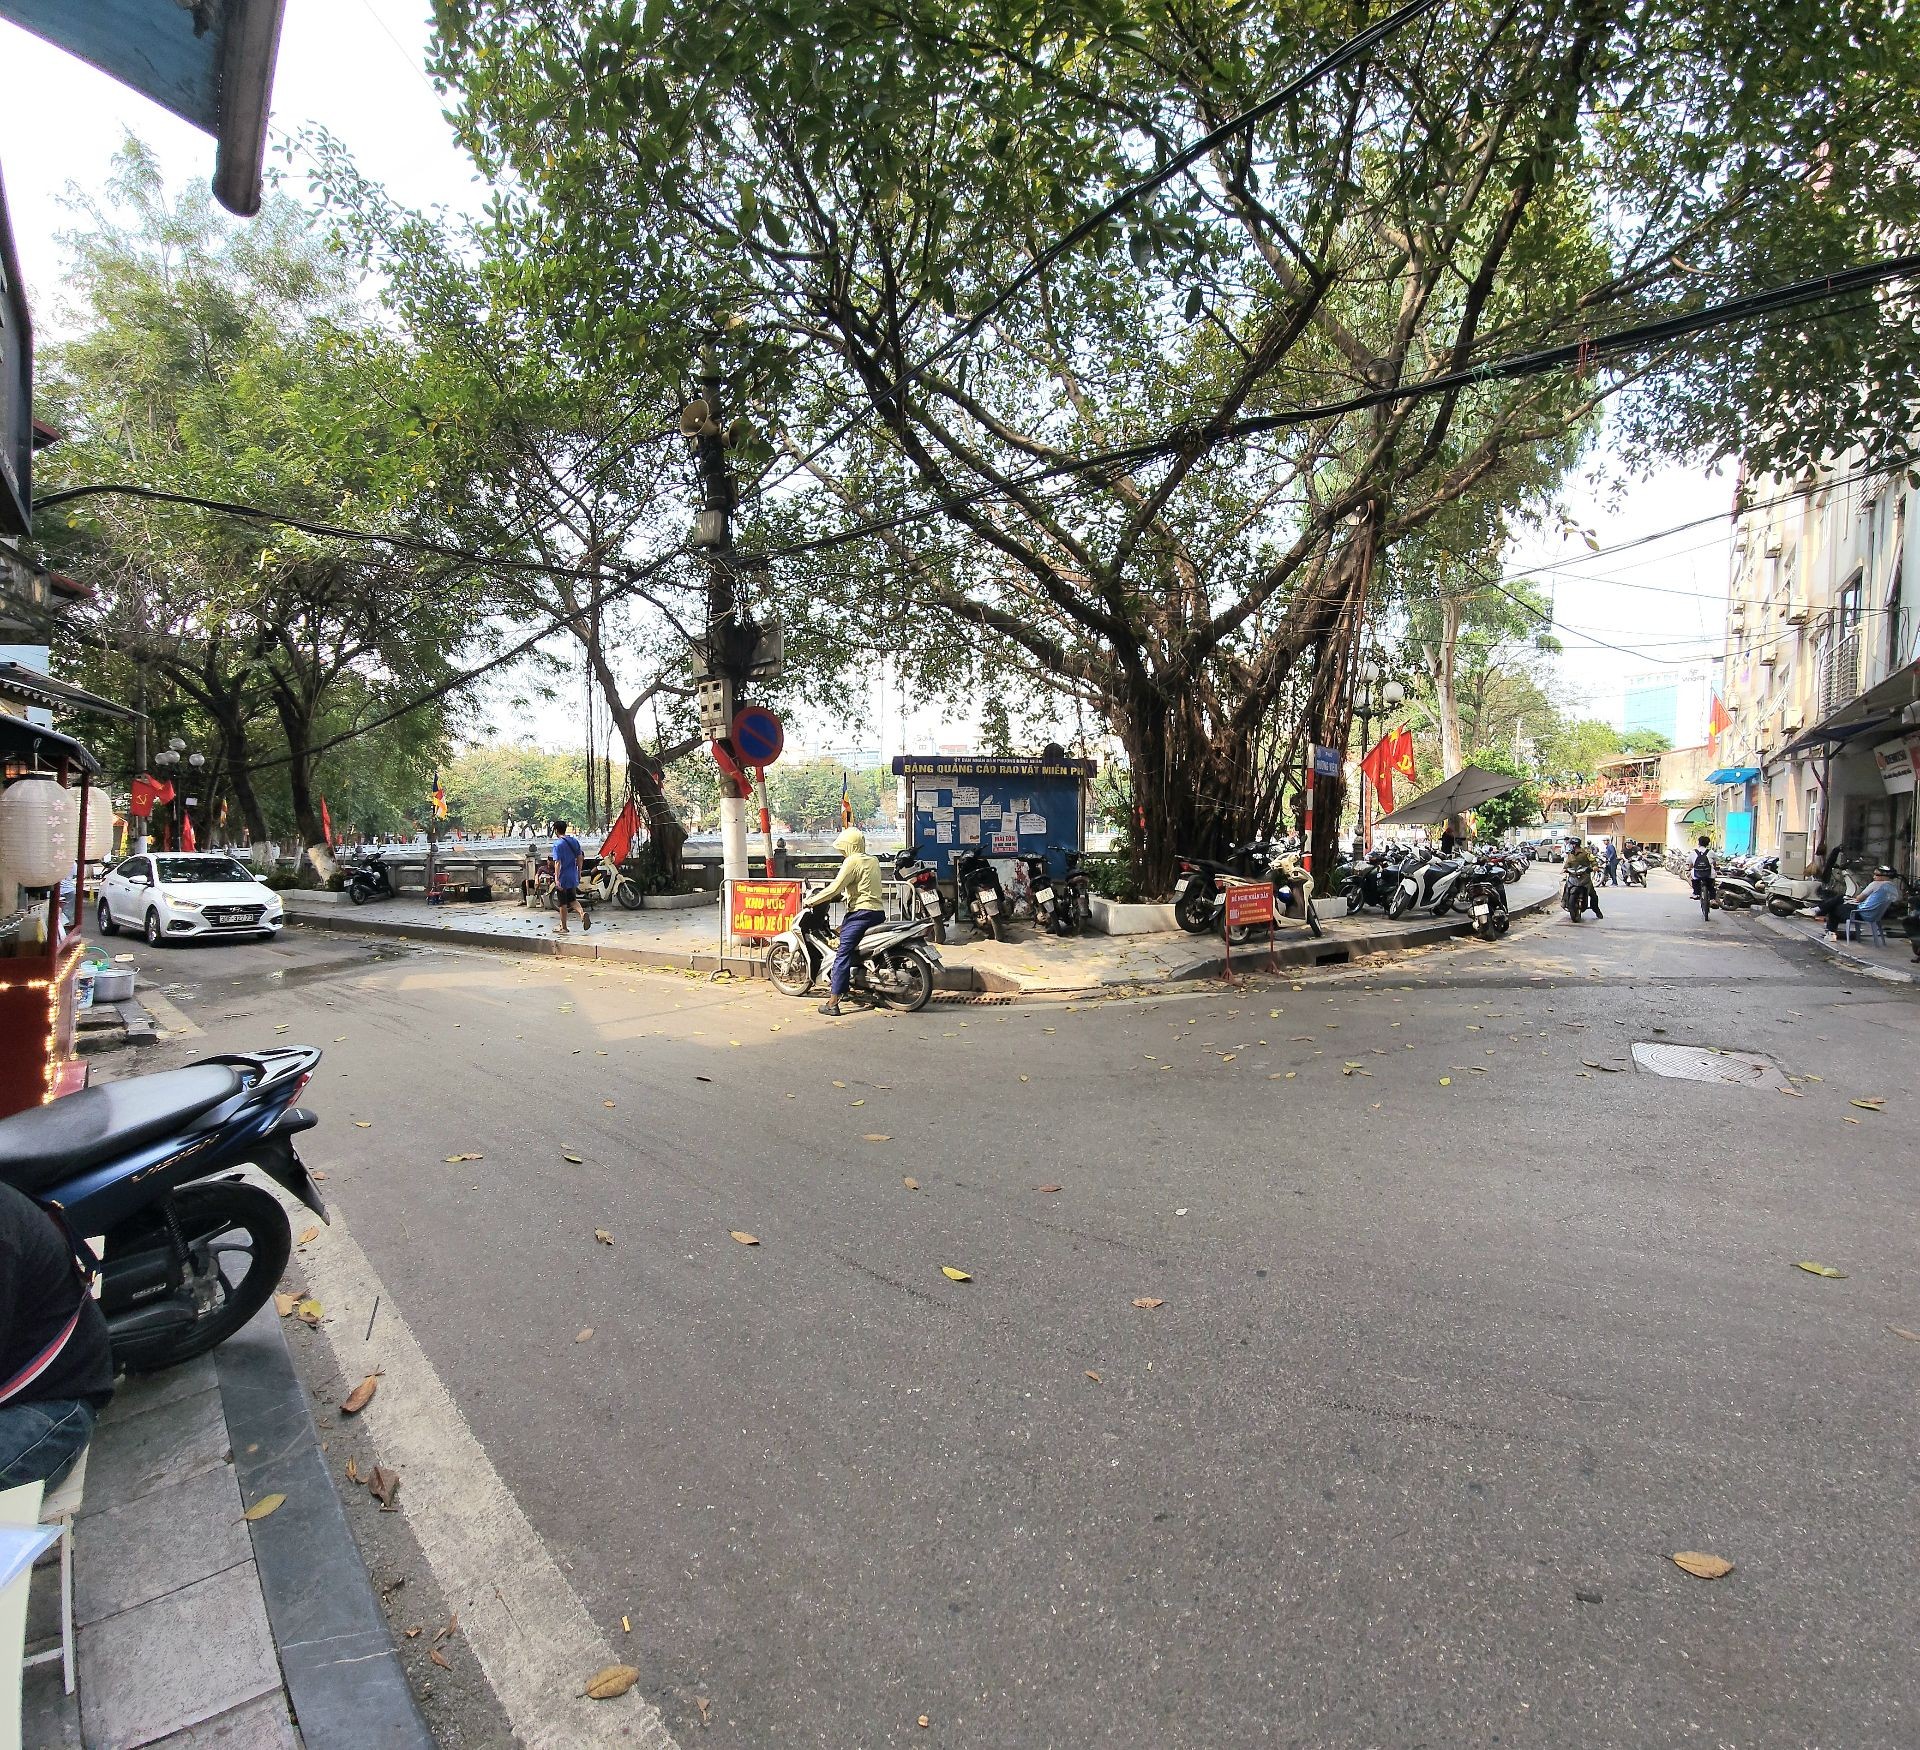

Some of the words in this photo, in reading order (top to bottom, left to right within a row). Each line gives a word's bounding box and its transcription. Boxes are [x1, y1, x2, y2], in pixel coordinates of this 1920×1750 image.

[904, 762, 934, 773] BẢNG
[937, 763, 973, 774] QUẢNG
[976, 763, 997, 774] CÁO
[999, 765, 1020, 774] RAO
[1020, 764, 1040, 776] VẶT
[1070, 766, 1087, 776] PH
[744, 896, 765, 910] KHU
[766, 897, 786, 912] VỰC
[765, 915, 777, 931] XE
